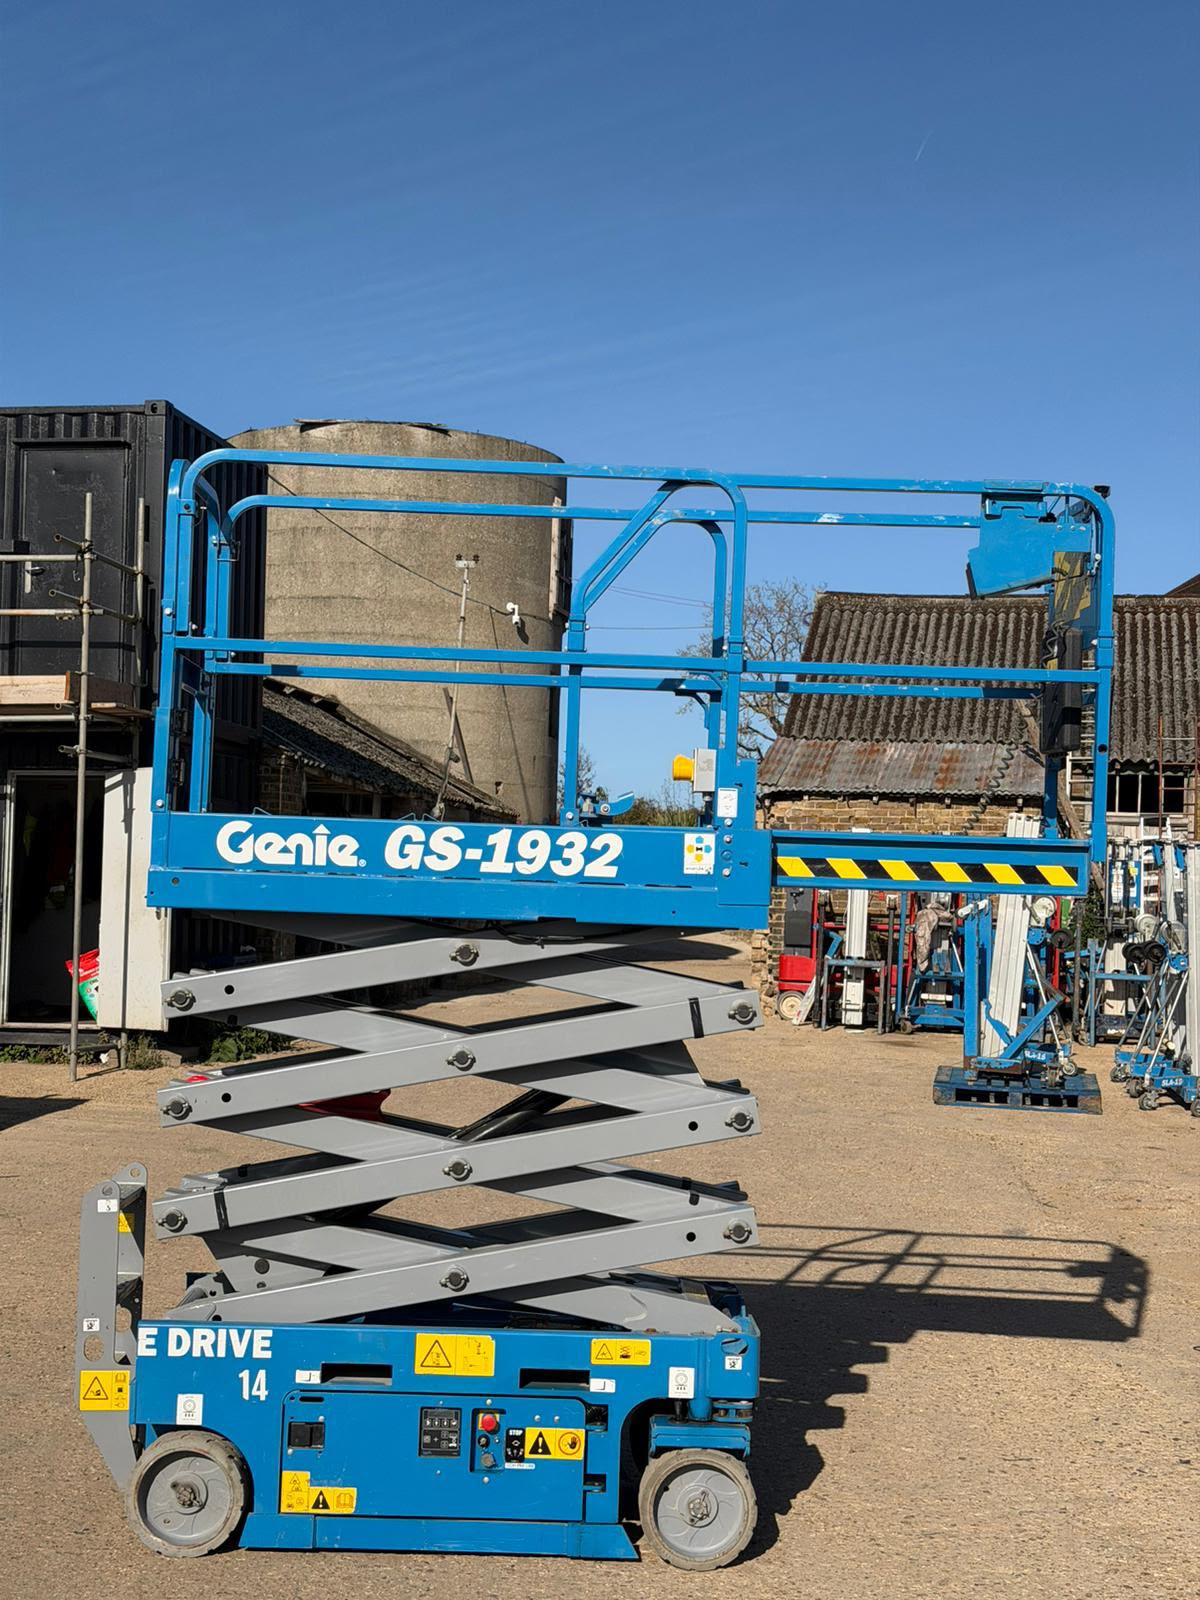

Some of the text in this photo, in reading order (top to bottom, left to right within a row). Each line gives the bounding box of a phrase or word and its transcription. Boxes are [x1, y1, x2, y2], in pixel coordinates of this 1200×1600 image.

[216, 820, 623, 877] Genie GS-1932
[137, 1327, 273, 1359] E DRIVE
[238, 1369, 268, 1401] 14
